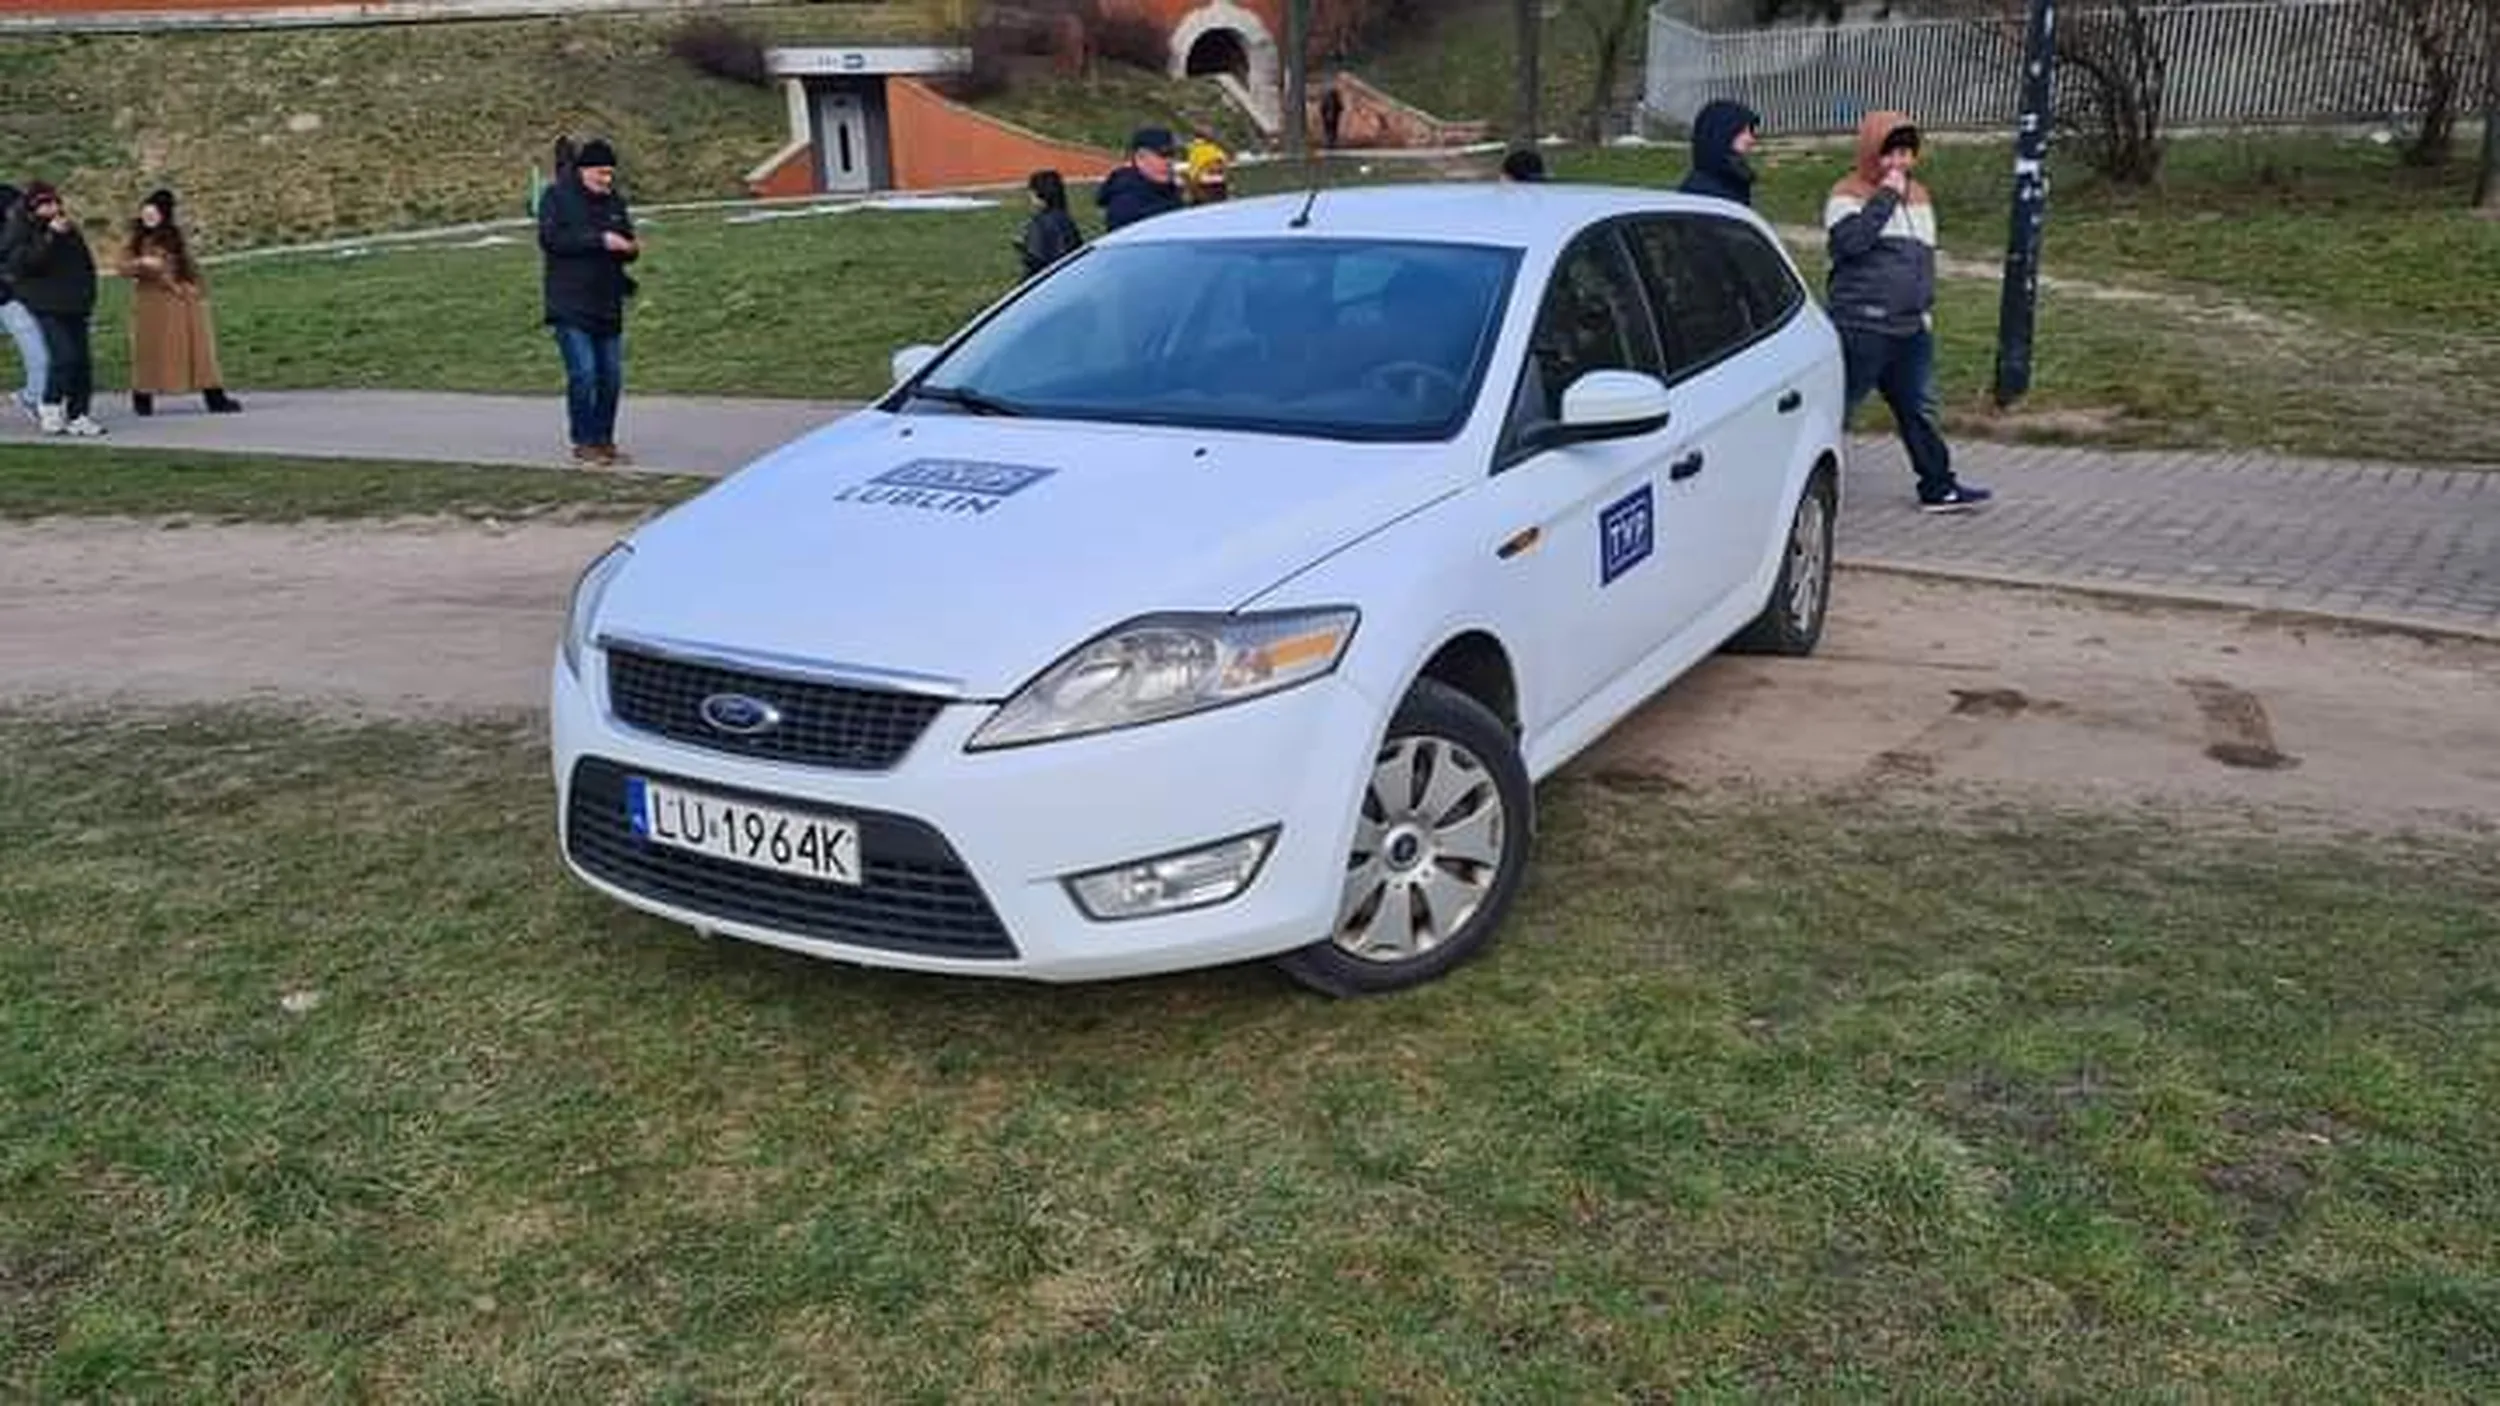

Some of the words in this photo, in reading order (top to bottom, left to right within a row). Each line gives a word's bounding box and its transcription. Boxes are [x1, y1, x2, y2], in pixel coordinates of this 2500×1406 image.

[833, 485, 1001, 514] LUBLIN
[1608, 506, 1647, 559] TVP
[654, 791, 705, 844] LU
[723, 807, 847, 875] 1964K
